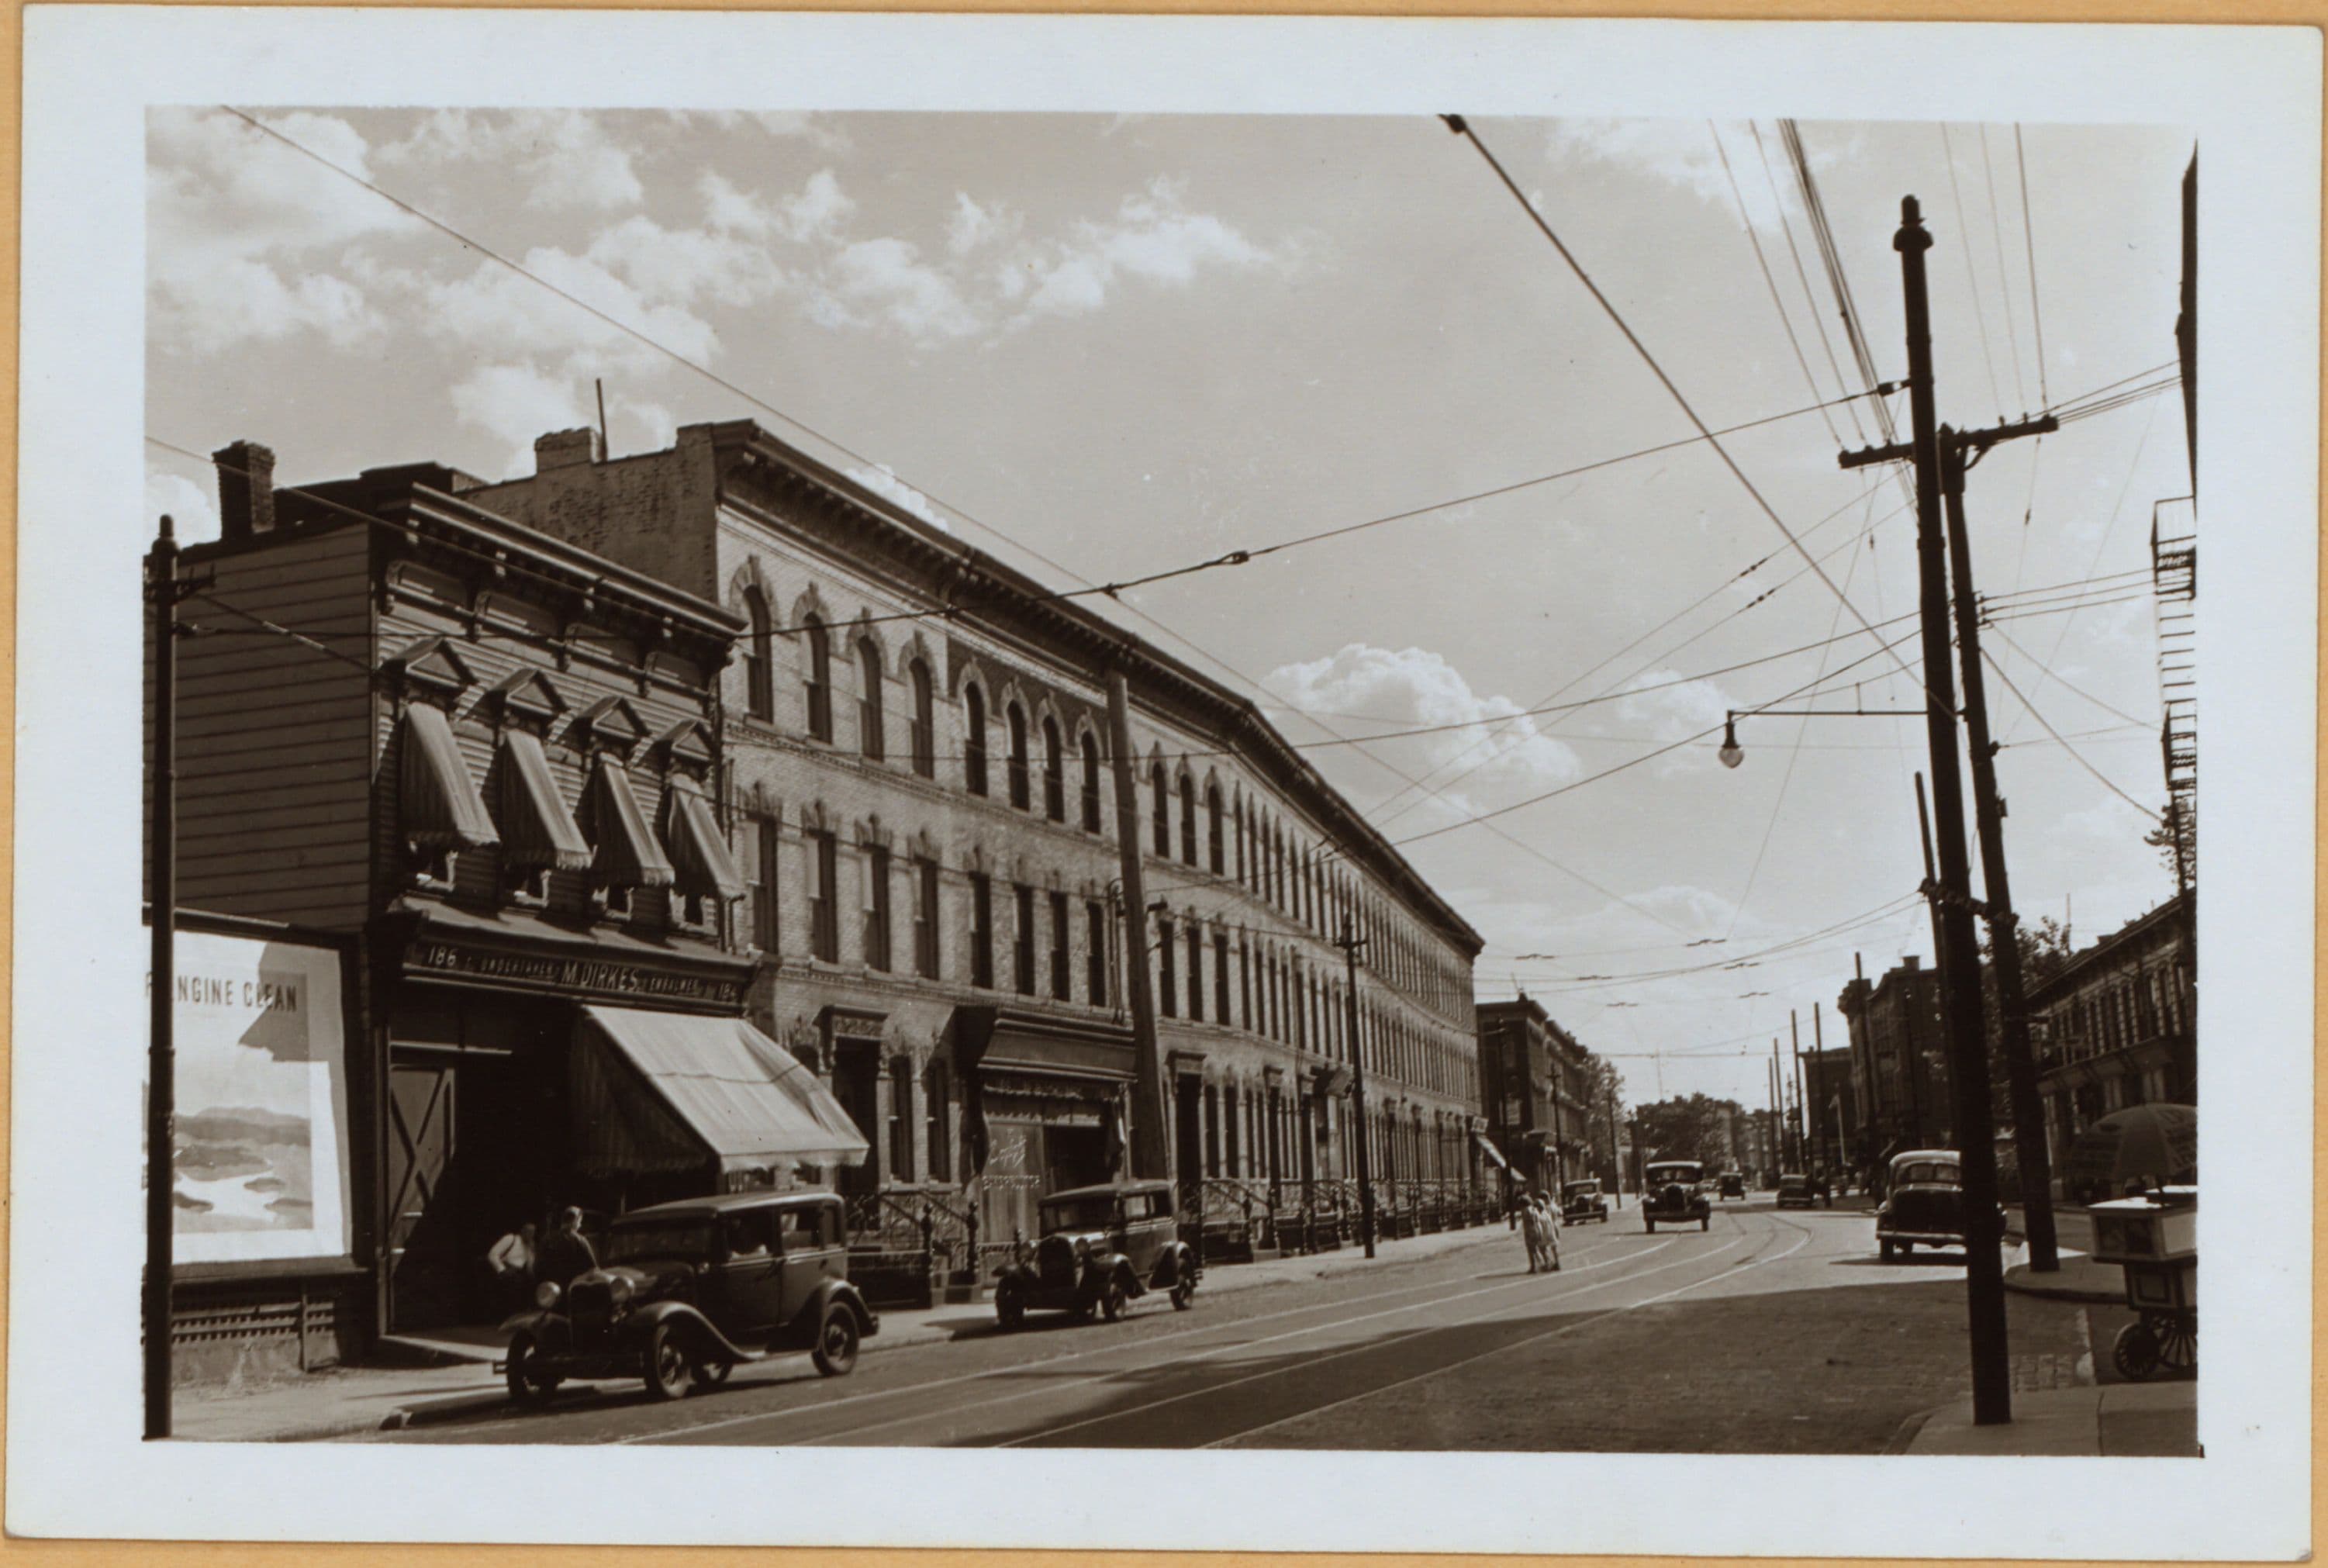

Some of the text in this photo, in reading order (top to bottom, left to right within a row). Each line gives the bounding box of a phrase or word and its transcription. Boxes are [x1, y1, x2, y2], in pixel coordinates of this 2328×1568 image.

[427, 946, 458, 967] 186
[174, 975, 234, 1005] NGINE
[244, 981, 296, 1011] CLEAN
